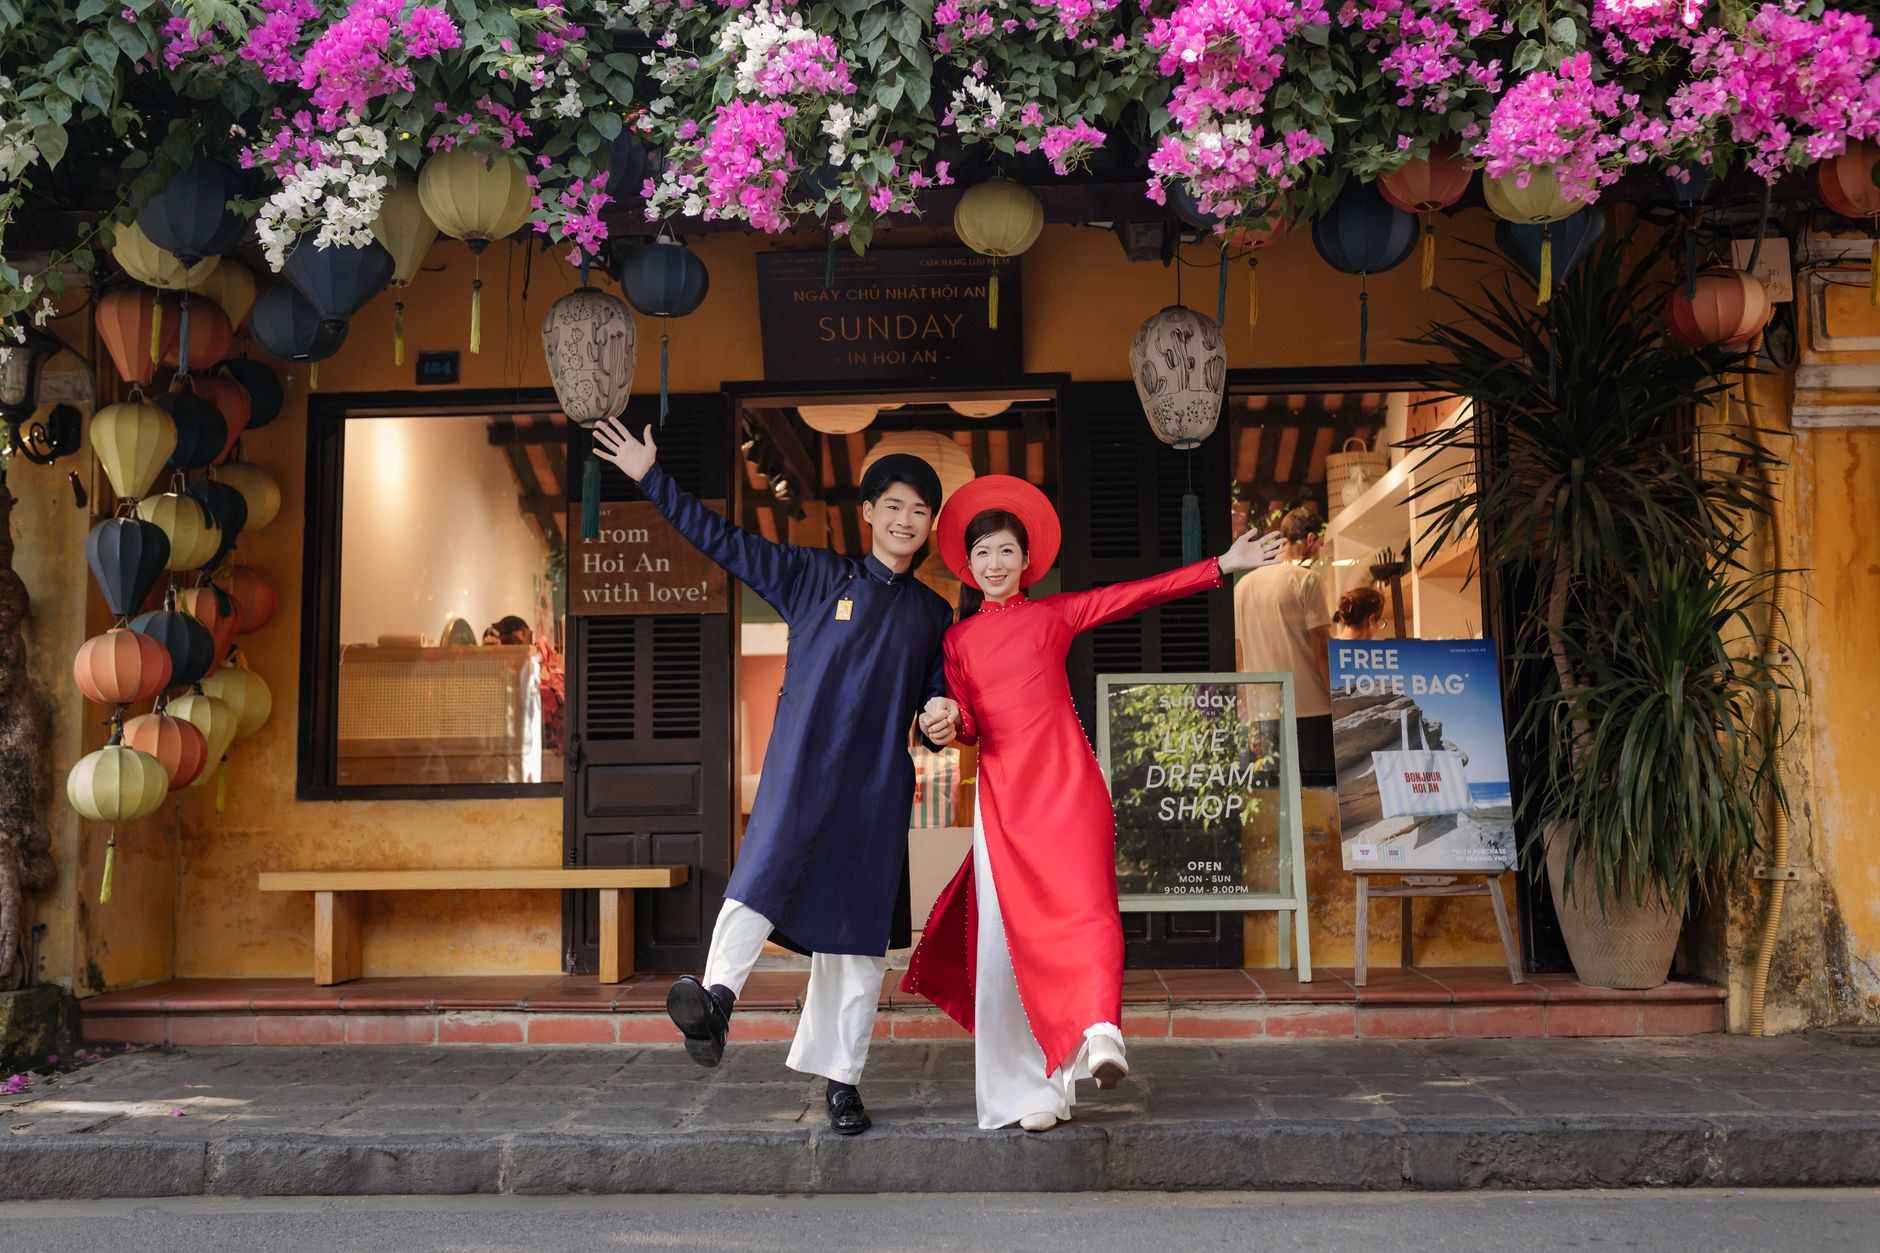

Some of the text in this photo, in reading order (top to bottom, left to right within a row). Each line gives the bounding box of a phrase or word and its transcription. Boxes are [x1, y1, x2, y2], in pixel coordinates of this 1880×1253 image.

[846, 283, 880, 301] CHỦ
[885, 284, 927, 302] NHẬT
[931, 283, 958, 301] HỘI
[963, 286, 986, 298] AN
[818, 313, 964, 342] SUNDAY
[847, 351, 866, 365] IN
[873, 350, 906, 365] HOI
[912, 349, 937, 363] AN
[583, 526, 650, 544] rom
[582, 552, 670, 574] Hoi An
[582, 580, 708, 603] with love!
[1338, 648, 1399, 670] FREE
[1340, 674, 1405, 696] TOTE
[1158, 690, 1237, 709] sunday
[1146, 762, 1262, 789] DREAM.
[1404, 771, 1442, 783] BONJOUR
[1412, 782, 1440, 794] HOI AN
[1158, 795, 1244, 823] SHOP.
[1187, 861, 1222, 872] OPEN
[1179, 875, 1203, 883] MON
[1211, 875, 1231, 883] SUN
[1189, 886, 1204, 894] AM
